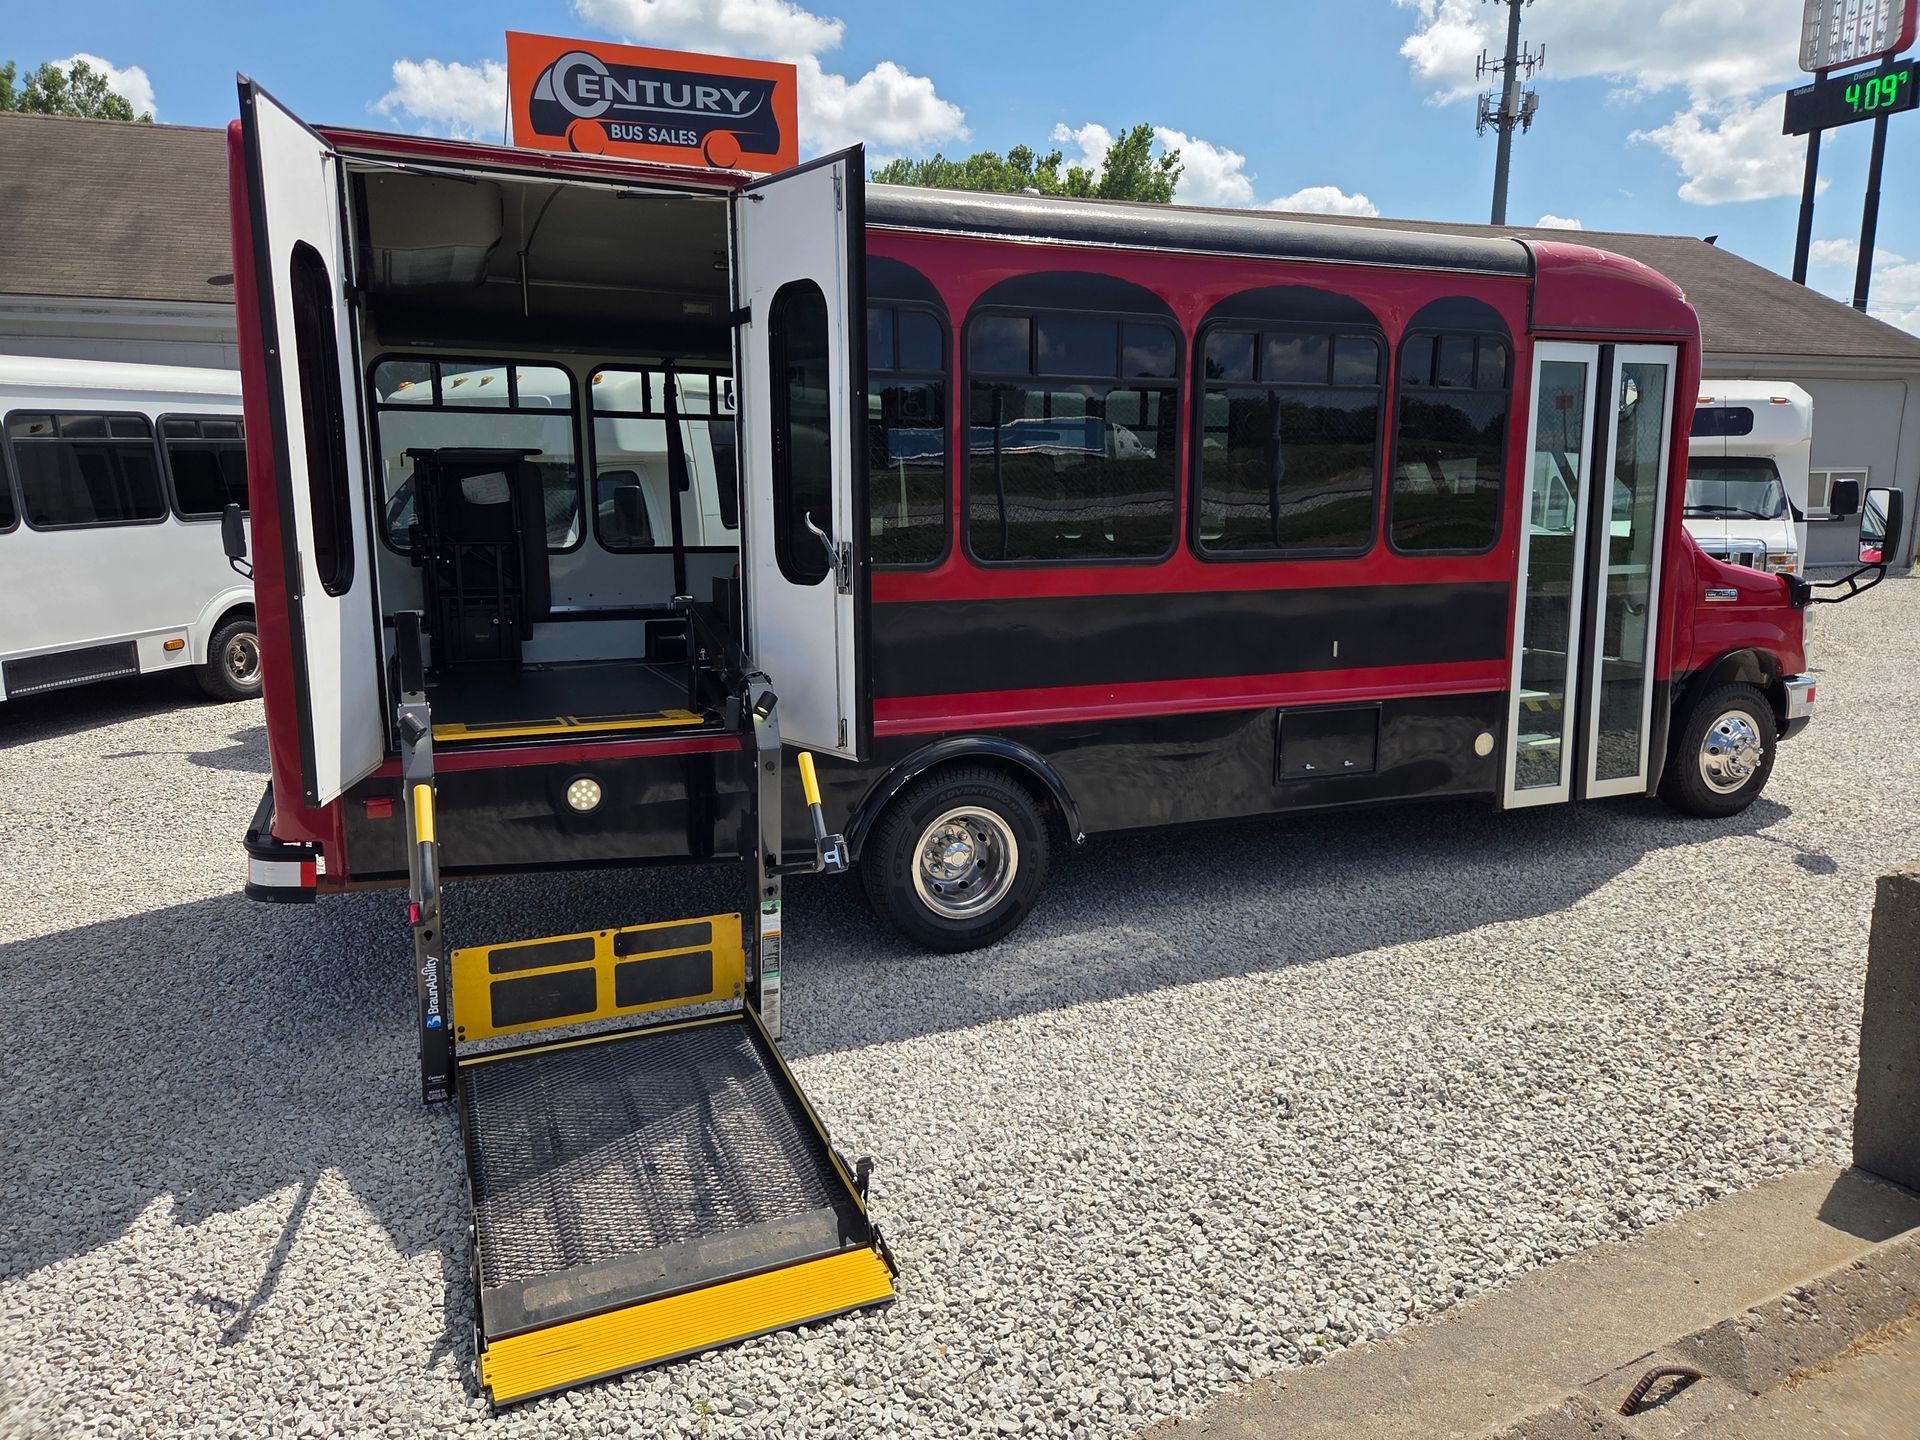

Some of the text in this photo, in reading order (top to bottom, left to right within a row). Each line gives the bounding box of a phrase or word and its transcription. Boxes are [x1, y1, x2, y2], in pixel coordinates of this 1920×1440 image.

[552, 51, 750, 118] CENTURY
[1853, 69, 1877, 81] Diesel
[611, 123, 698, 145] BUS SALES
[421, 955, 440, 1014] BraunAbility
